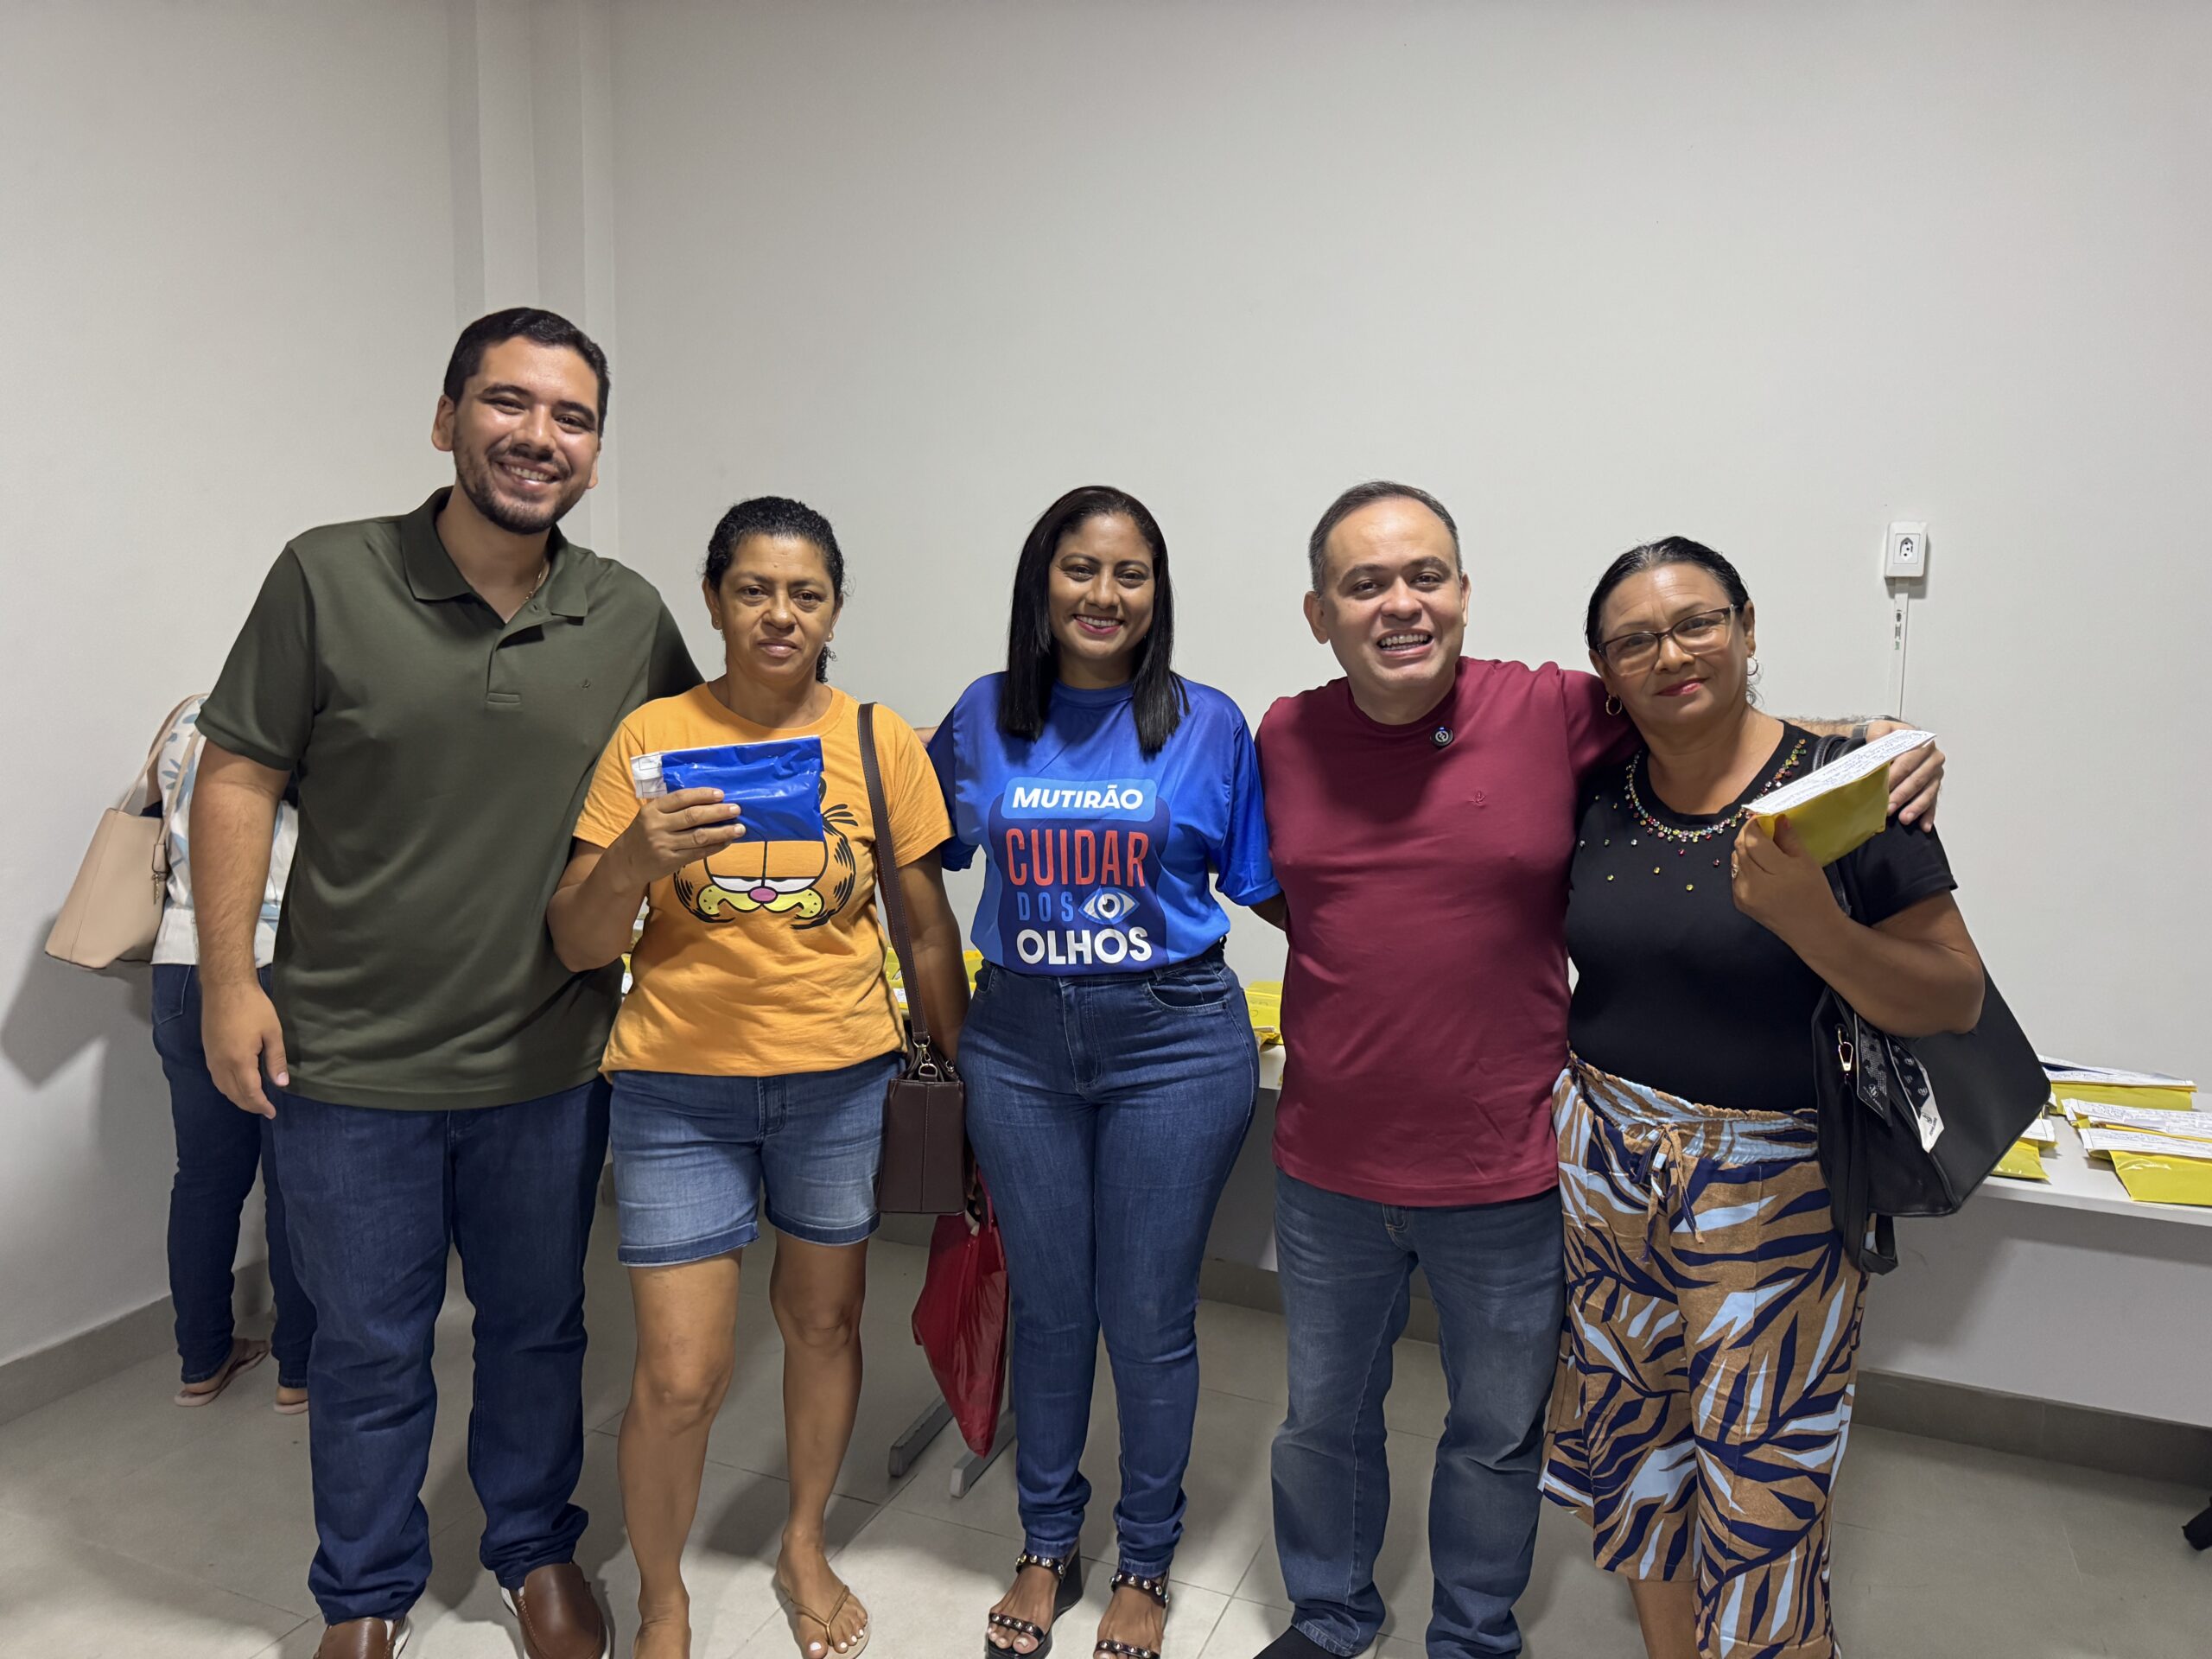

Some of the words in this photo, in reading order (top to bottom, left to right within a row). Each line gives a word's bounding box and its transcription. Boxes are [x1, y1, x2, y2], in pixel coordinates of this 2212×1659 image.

[1012, 785, 1143, 810] MUTIRÃO
[1006, 829, 1148, 887] CUIDAR
[1017, 892, 1074, 921] DOS
[1016, 926, 1152, 965] OLHOS
